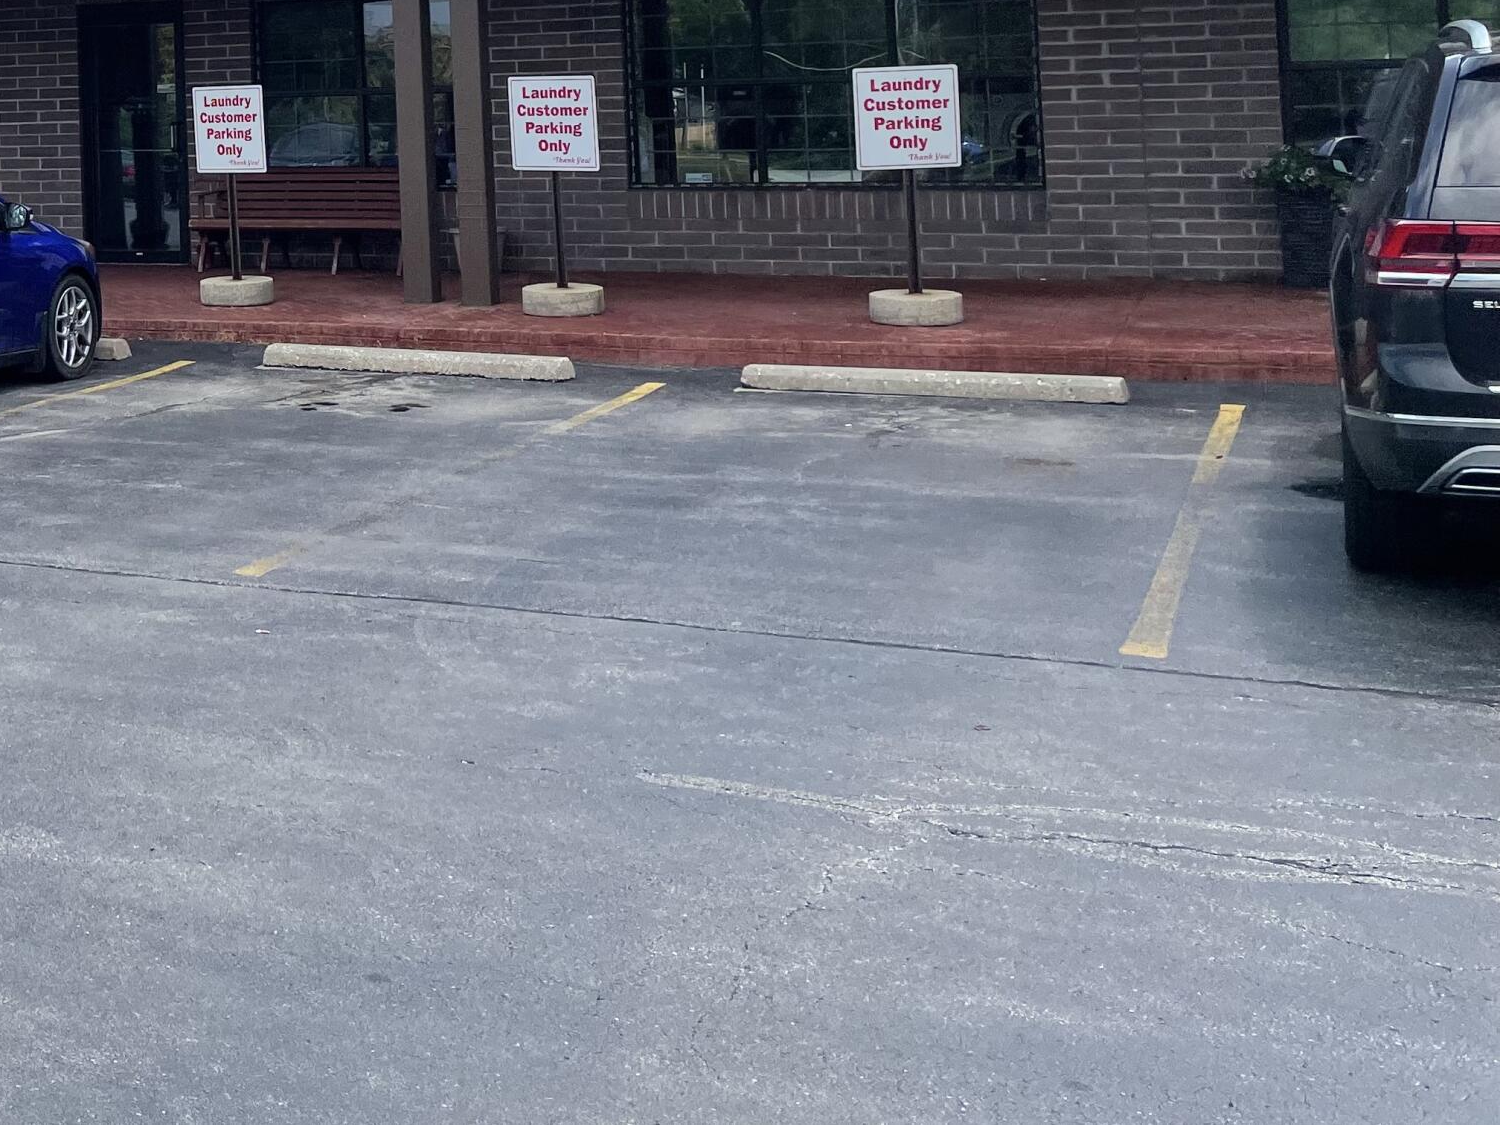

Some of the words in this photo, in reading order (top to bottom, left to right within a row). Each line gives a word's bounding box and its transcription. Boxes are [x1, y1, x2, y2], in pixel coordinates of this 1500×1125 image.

[869, 77, 942, 93] Laundry
[522, 86, 582, 101] Laundry
[203, 94, 251, 109] Laundry
[863, 97, 950, 112] Customer
[200, 111, 257, 124] Customer
[517, 104, 589, 116] Customer
[525, 121, 582, 137] Parking
[874, 115, 942, 131] Parking
[206, 127, 252, 141] Parking
[217, 143, 243, 158] Only
[538, 139, 571, 154] Only
[889, 135, 928, 151] Only
